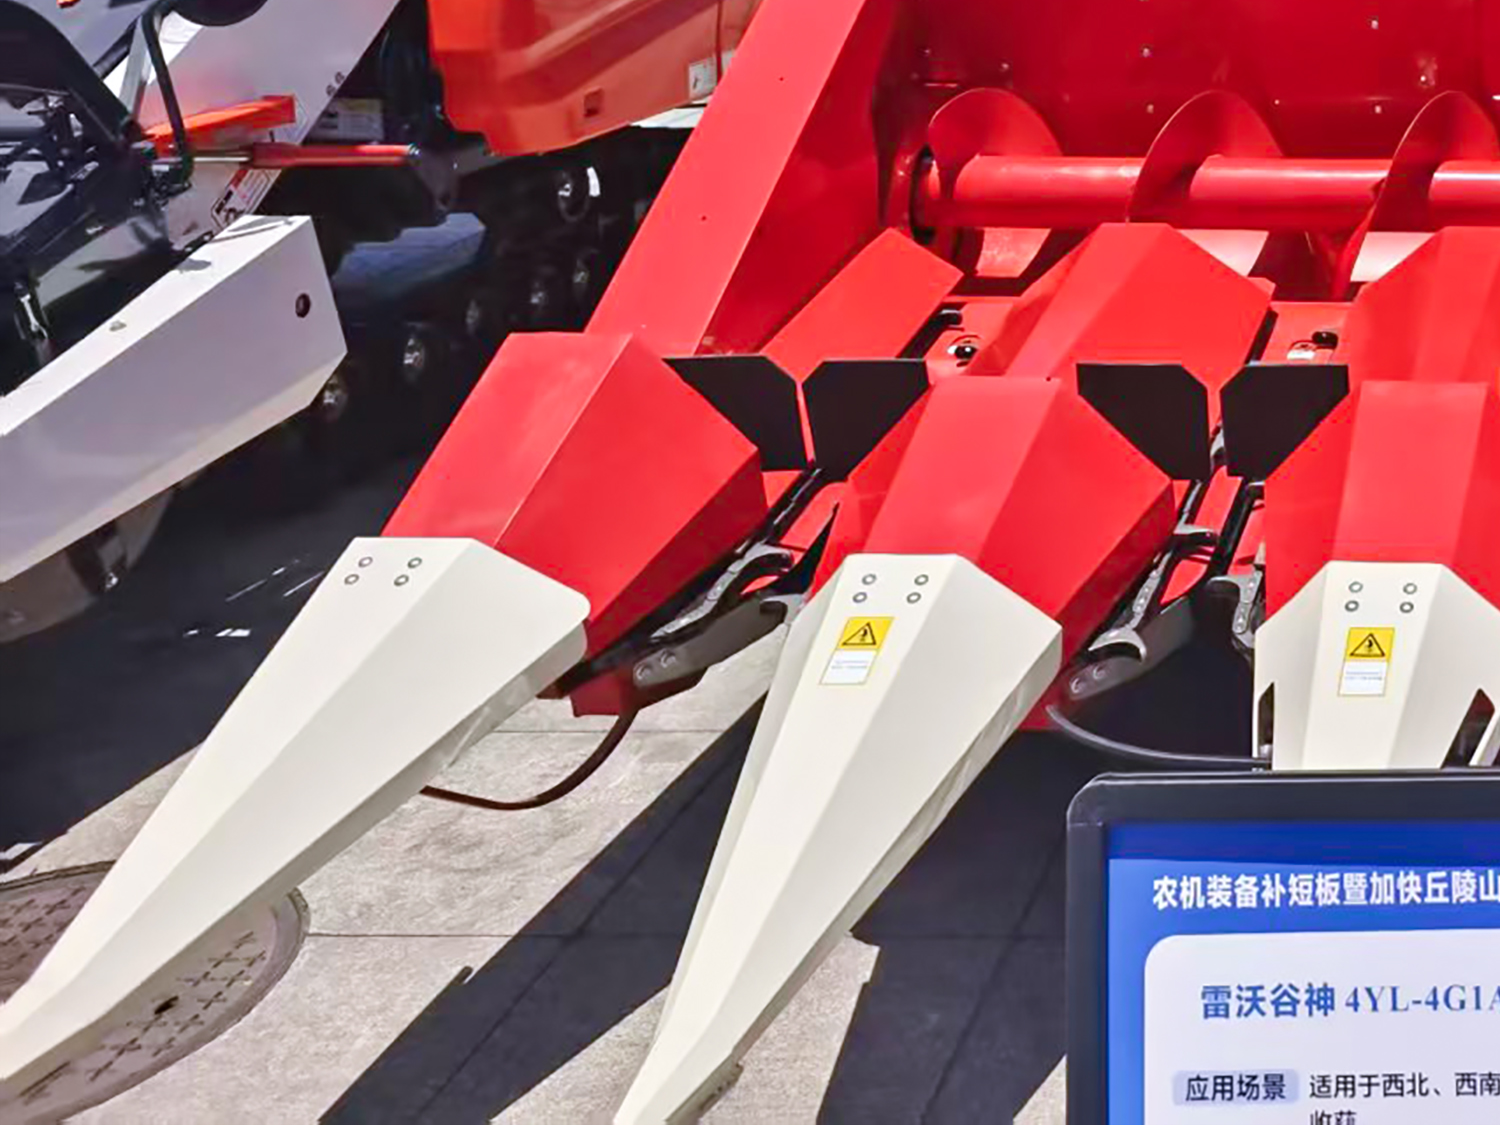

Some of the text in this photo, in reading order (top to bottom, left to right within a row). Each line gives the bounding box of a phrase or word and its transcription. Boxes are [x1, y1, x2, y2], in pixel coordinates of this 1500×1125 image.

[1201, 983, 1336, 1019] 雷沃谷神
[1185, 1074, 1286, 1102] 应用场景
